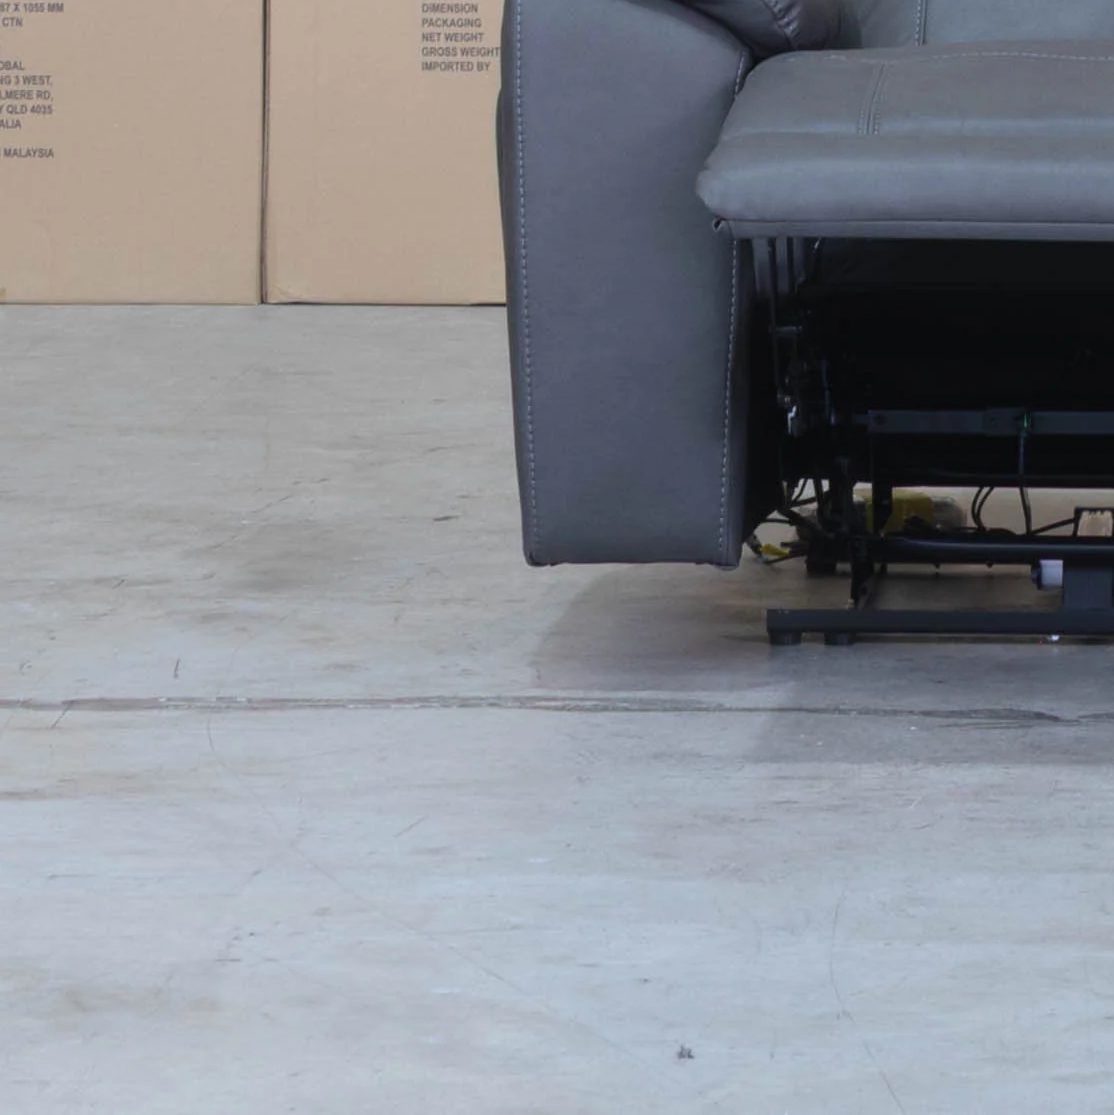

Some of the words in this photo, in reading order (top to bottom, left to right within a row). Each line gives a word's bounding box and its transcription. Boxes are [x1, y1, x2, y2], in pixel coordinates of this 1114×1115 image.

[421, 3, 478, 13] DIMENSION
[421, 18, 482, 28] PACKAGING
[444, 32, 485, 42] WEIGHT
[421, 46, 457, 57] GROSS
[460, 47, 500, 57] WEIGHT
[421, 61, 474, 72] IMPORTED
[3, 148, 54, 158] MALAYSIA
